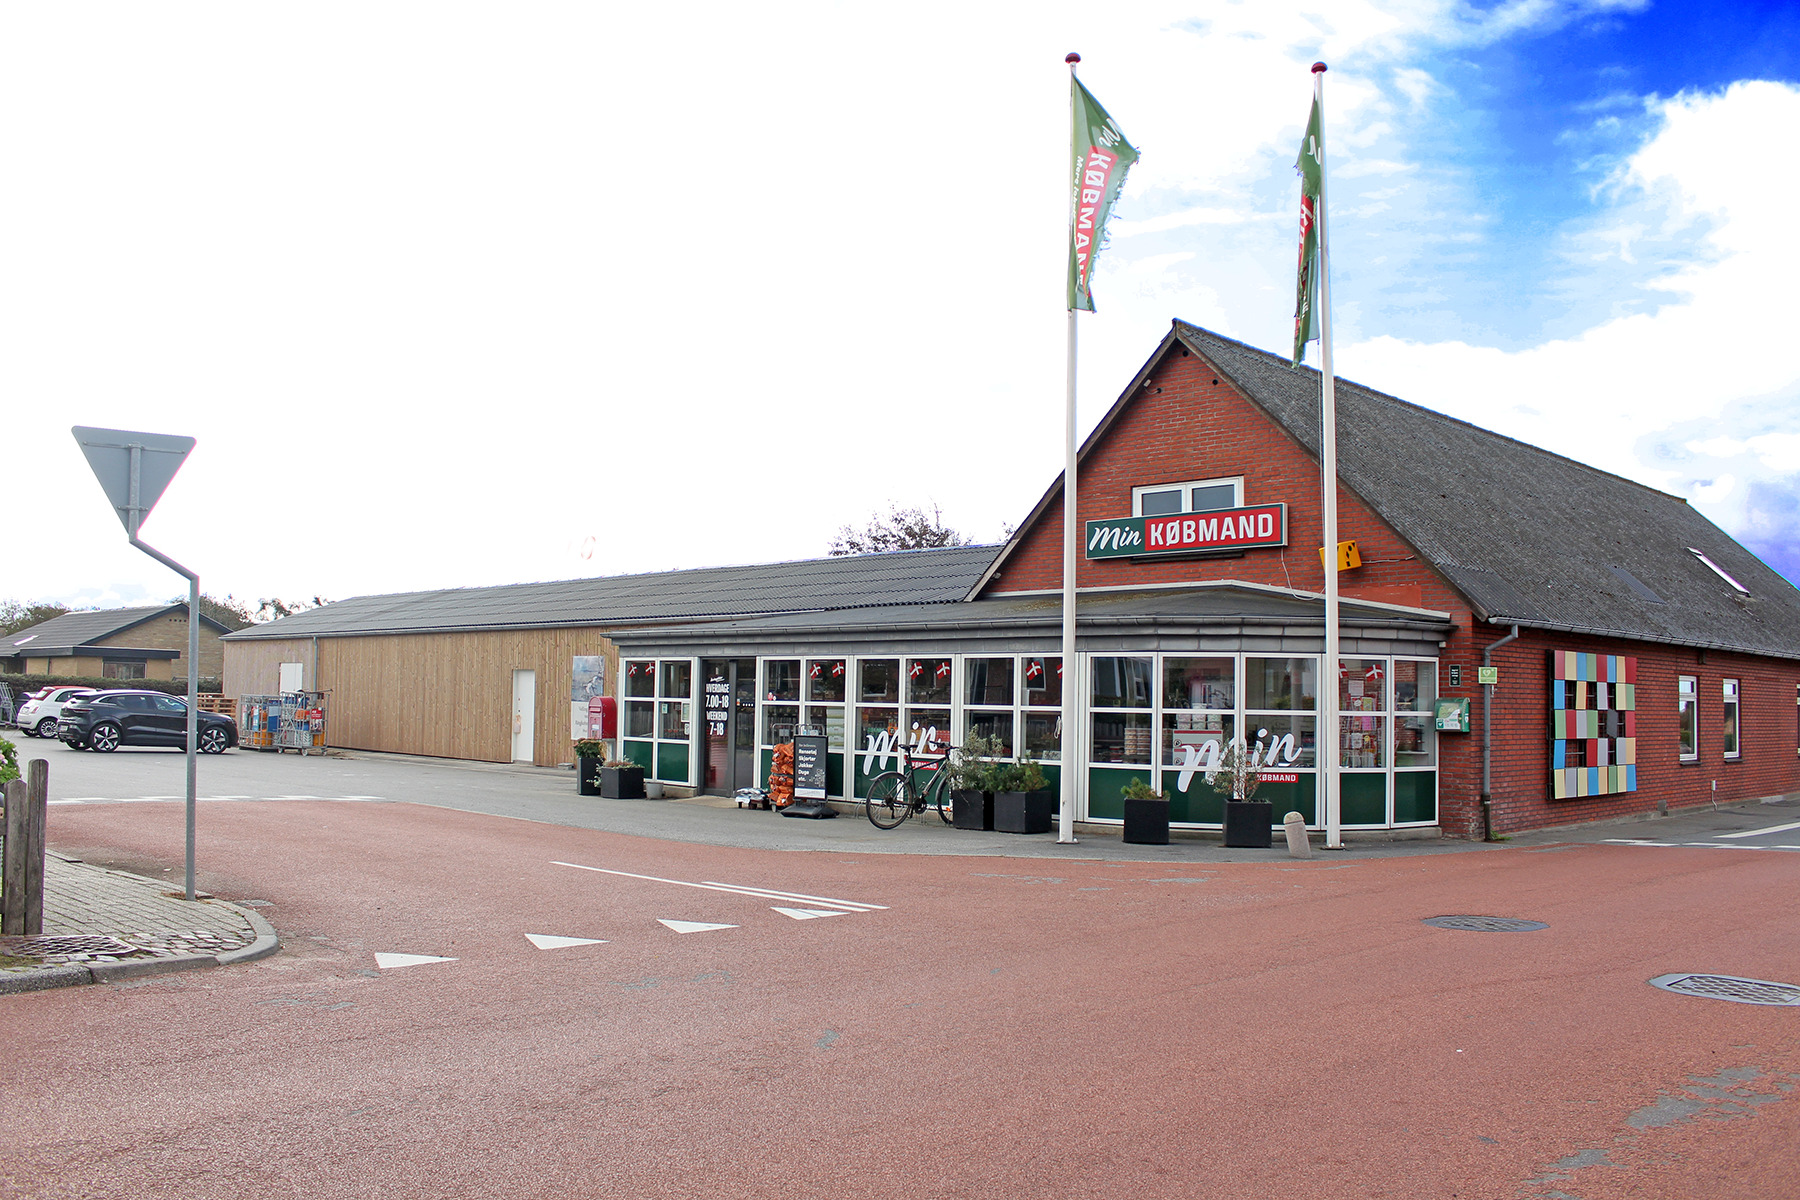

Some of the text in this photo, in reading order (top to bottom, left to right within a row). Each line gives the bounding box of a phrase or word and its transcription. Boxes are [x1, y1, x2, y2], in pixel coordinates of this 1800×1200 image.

[1074, 155, 1085, 185] Mere
[1088, 513, 1273, 551] Min KØBMAND
[705, 683, 730, 693] HVERDAGE
[705, 711, 728, 721] WEEKEND
[709, 722, 725, 736] 7-18
[1256, 773, 1296, 782] KØBMAND
